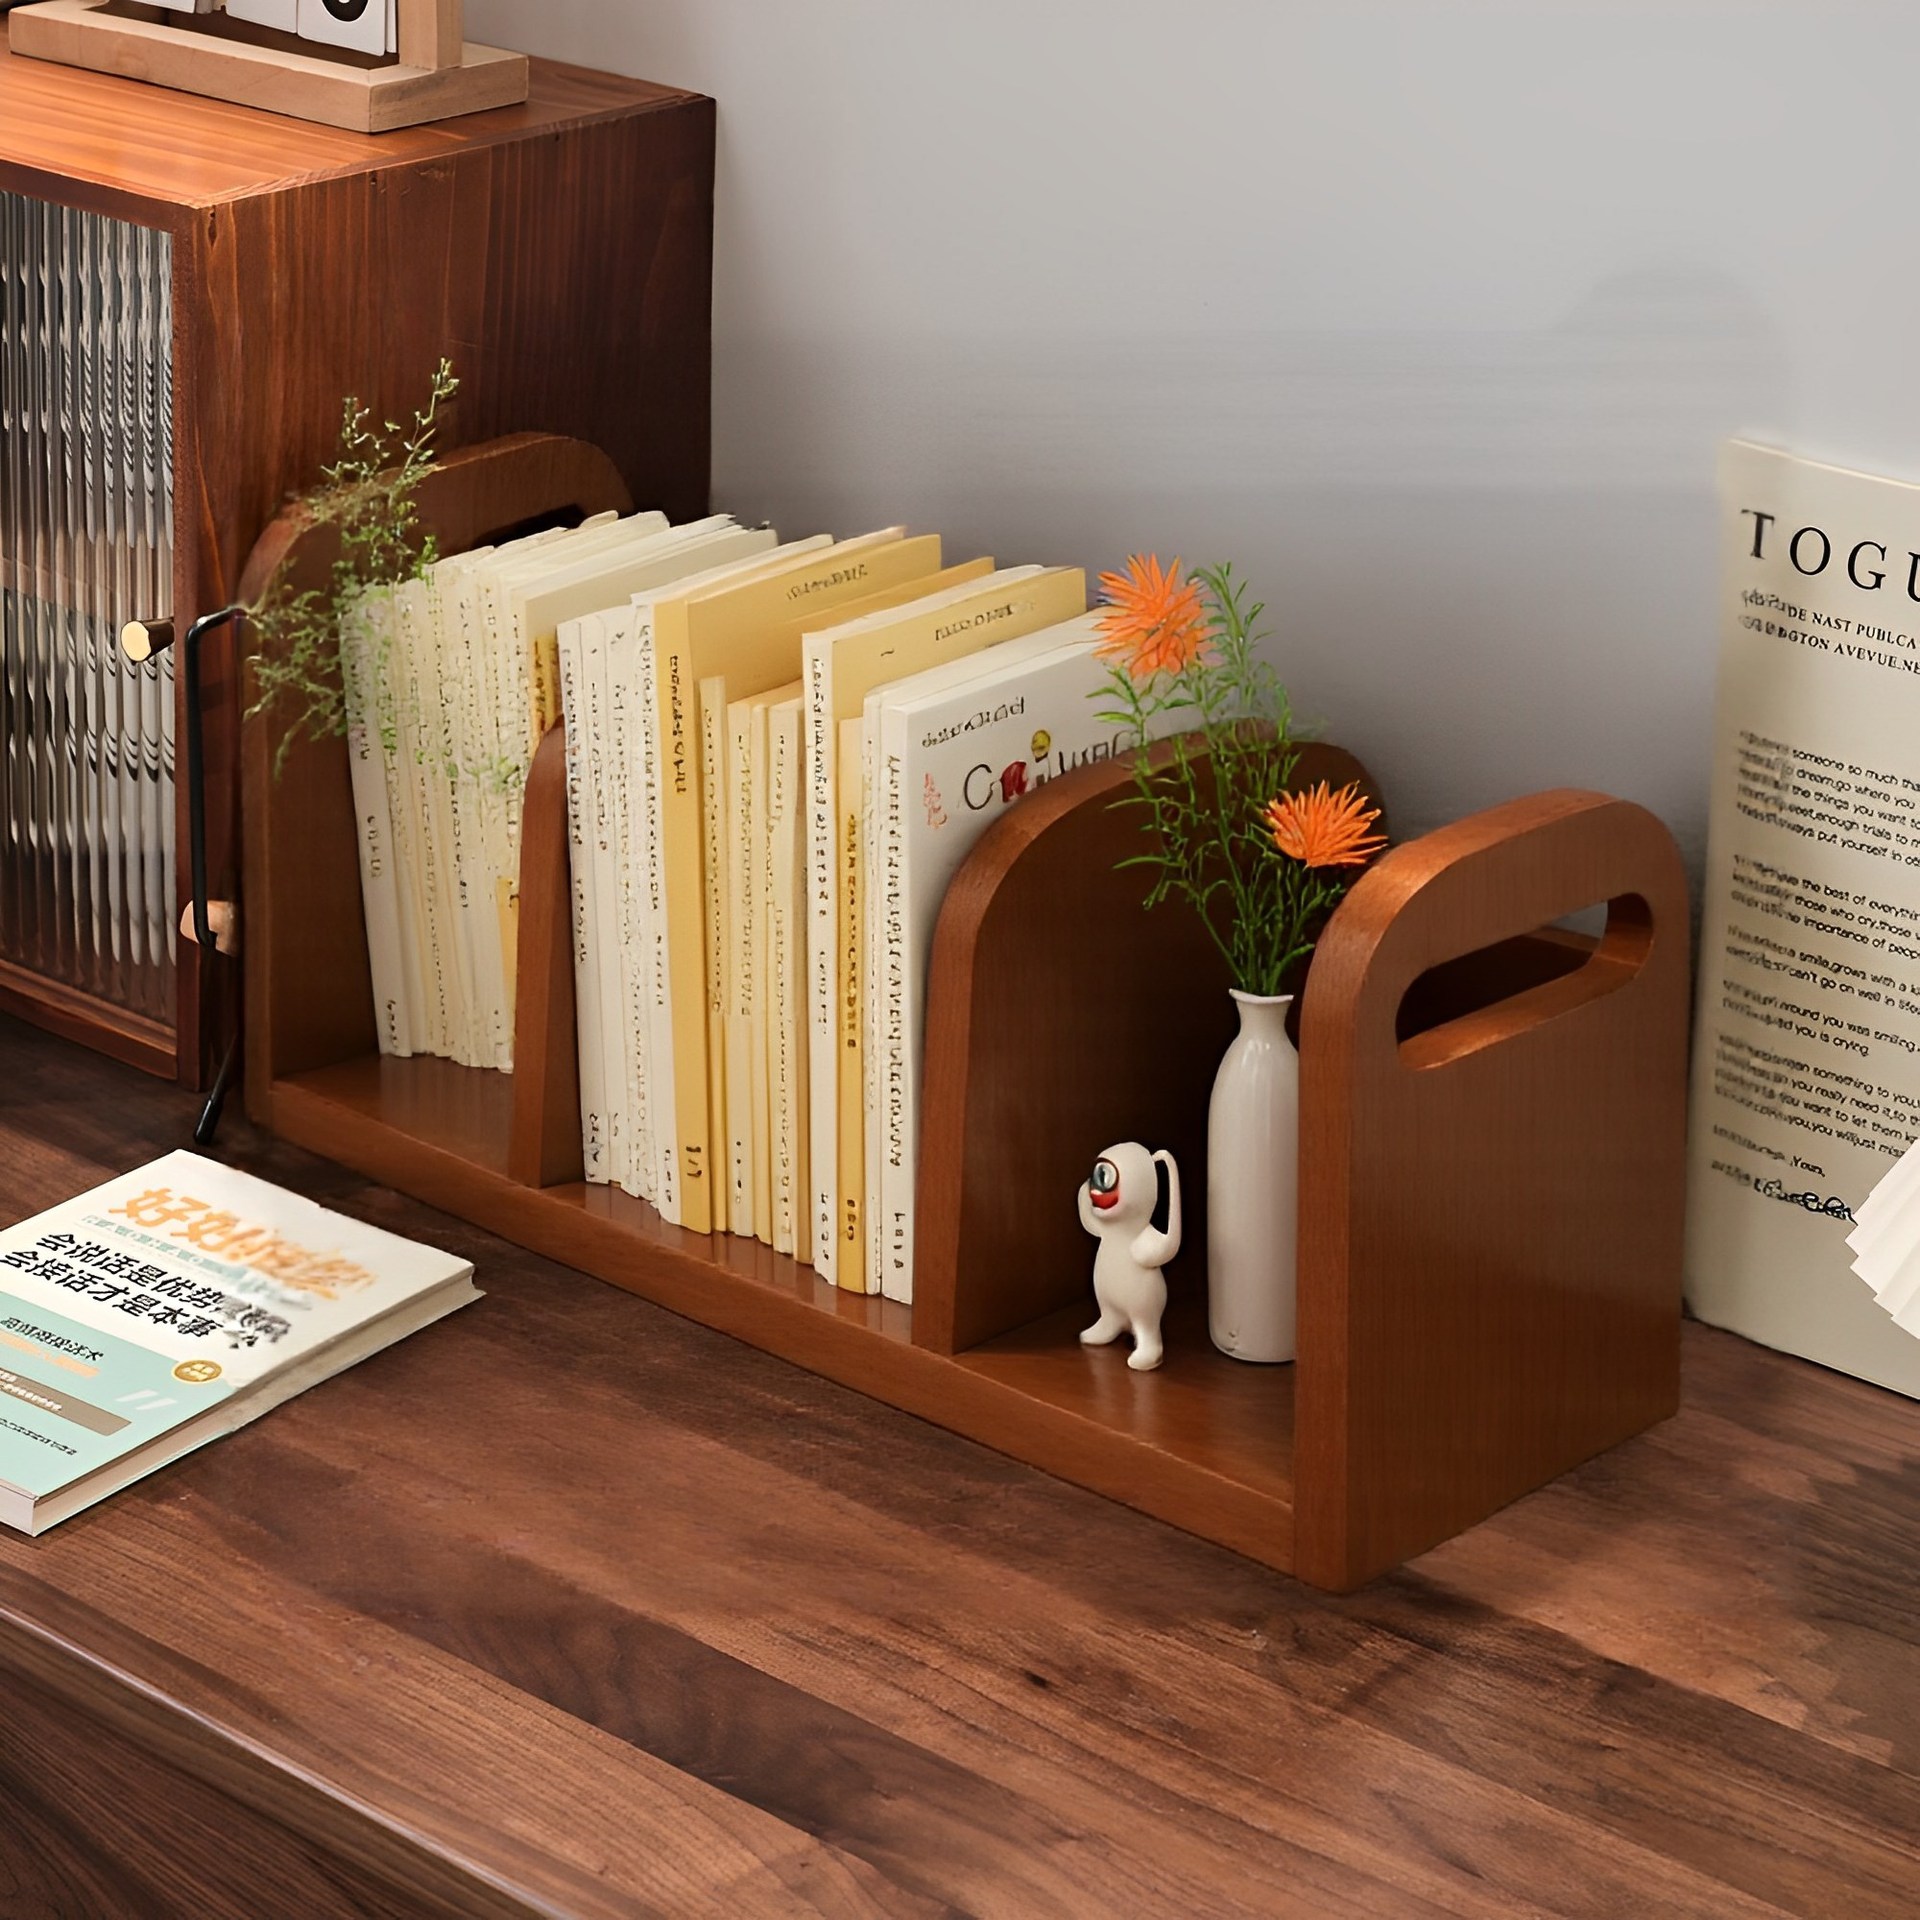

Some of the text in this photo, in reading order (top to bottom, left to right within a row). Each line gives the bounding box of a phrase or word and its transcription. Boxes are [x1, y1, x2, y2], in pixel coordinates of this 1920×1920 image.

[1812, 611, 1852, 633] NAST
[1853, 804, 1875, 817] you
[1894, 797, 1915, 810] you
[1823, 1013, 1844, 1029] you
[1794, 1024, 1817, 1039] you
[1791, 1079, 1814, 1093] you
